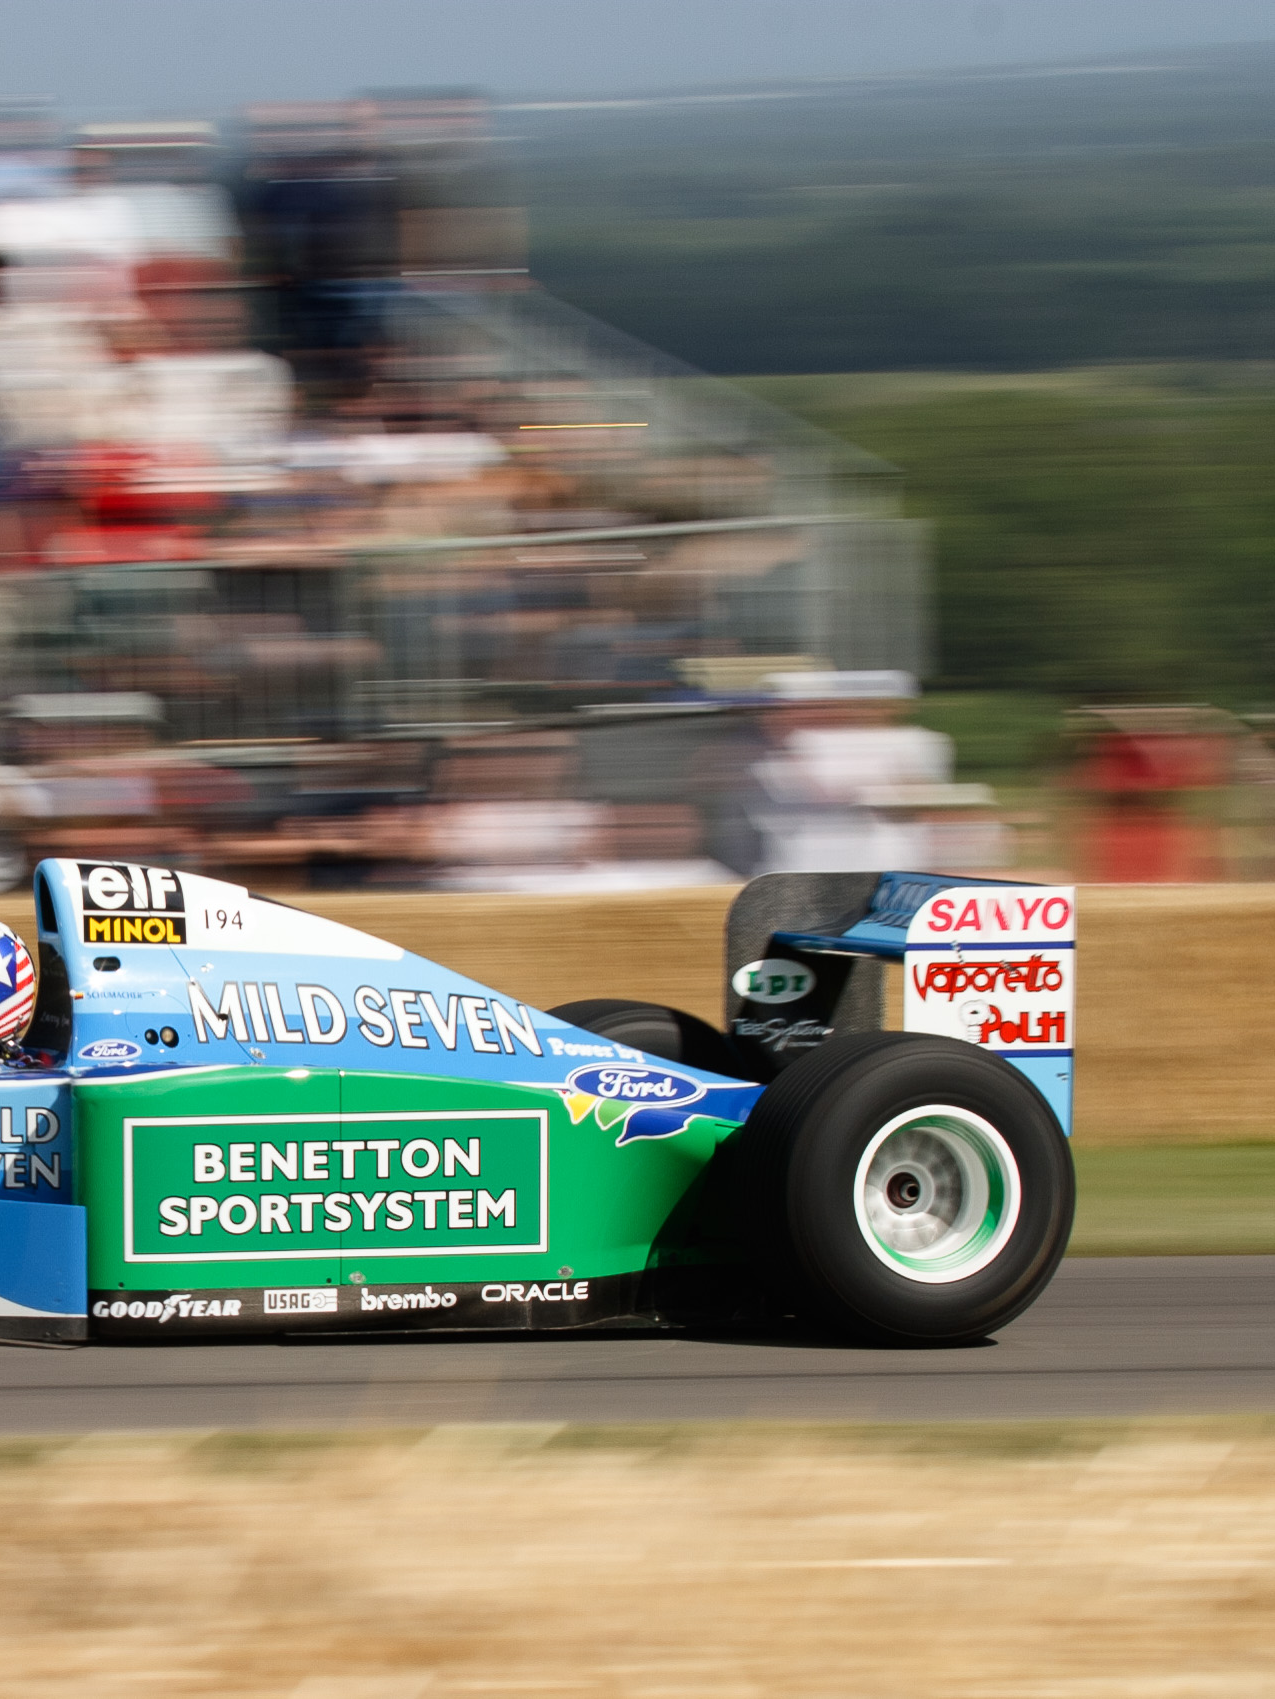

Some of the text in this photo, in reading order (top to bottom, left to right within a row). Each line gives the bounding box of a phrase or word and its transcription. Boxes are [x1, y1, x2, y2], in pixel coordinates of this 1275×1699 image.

[88, 866, 177, 909] elf
[89, 917, 181, 943] MINOL
[205, 909, 243, 930] 194
[87, 991, 142, 999] SCHUMACHER
[187, 981, 545, 1057] MILD SEVEN
[92, 1042, 128, 1057] Ford
[546, 1037, 614, 1057] Power
[598, 1068, 677, 1097] Ford
[193, 1137, 481, 1184] BENETTON
[158, 1188, 517, 1238] SPORTSYSTEM
[268, 1293, 311, 1310] USAG
[361, 1285, 457, 1311] brembo
[481, 1281, 589, 1302] ORACLE
